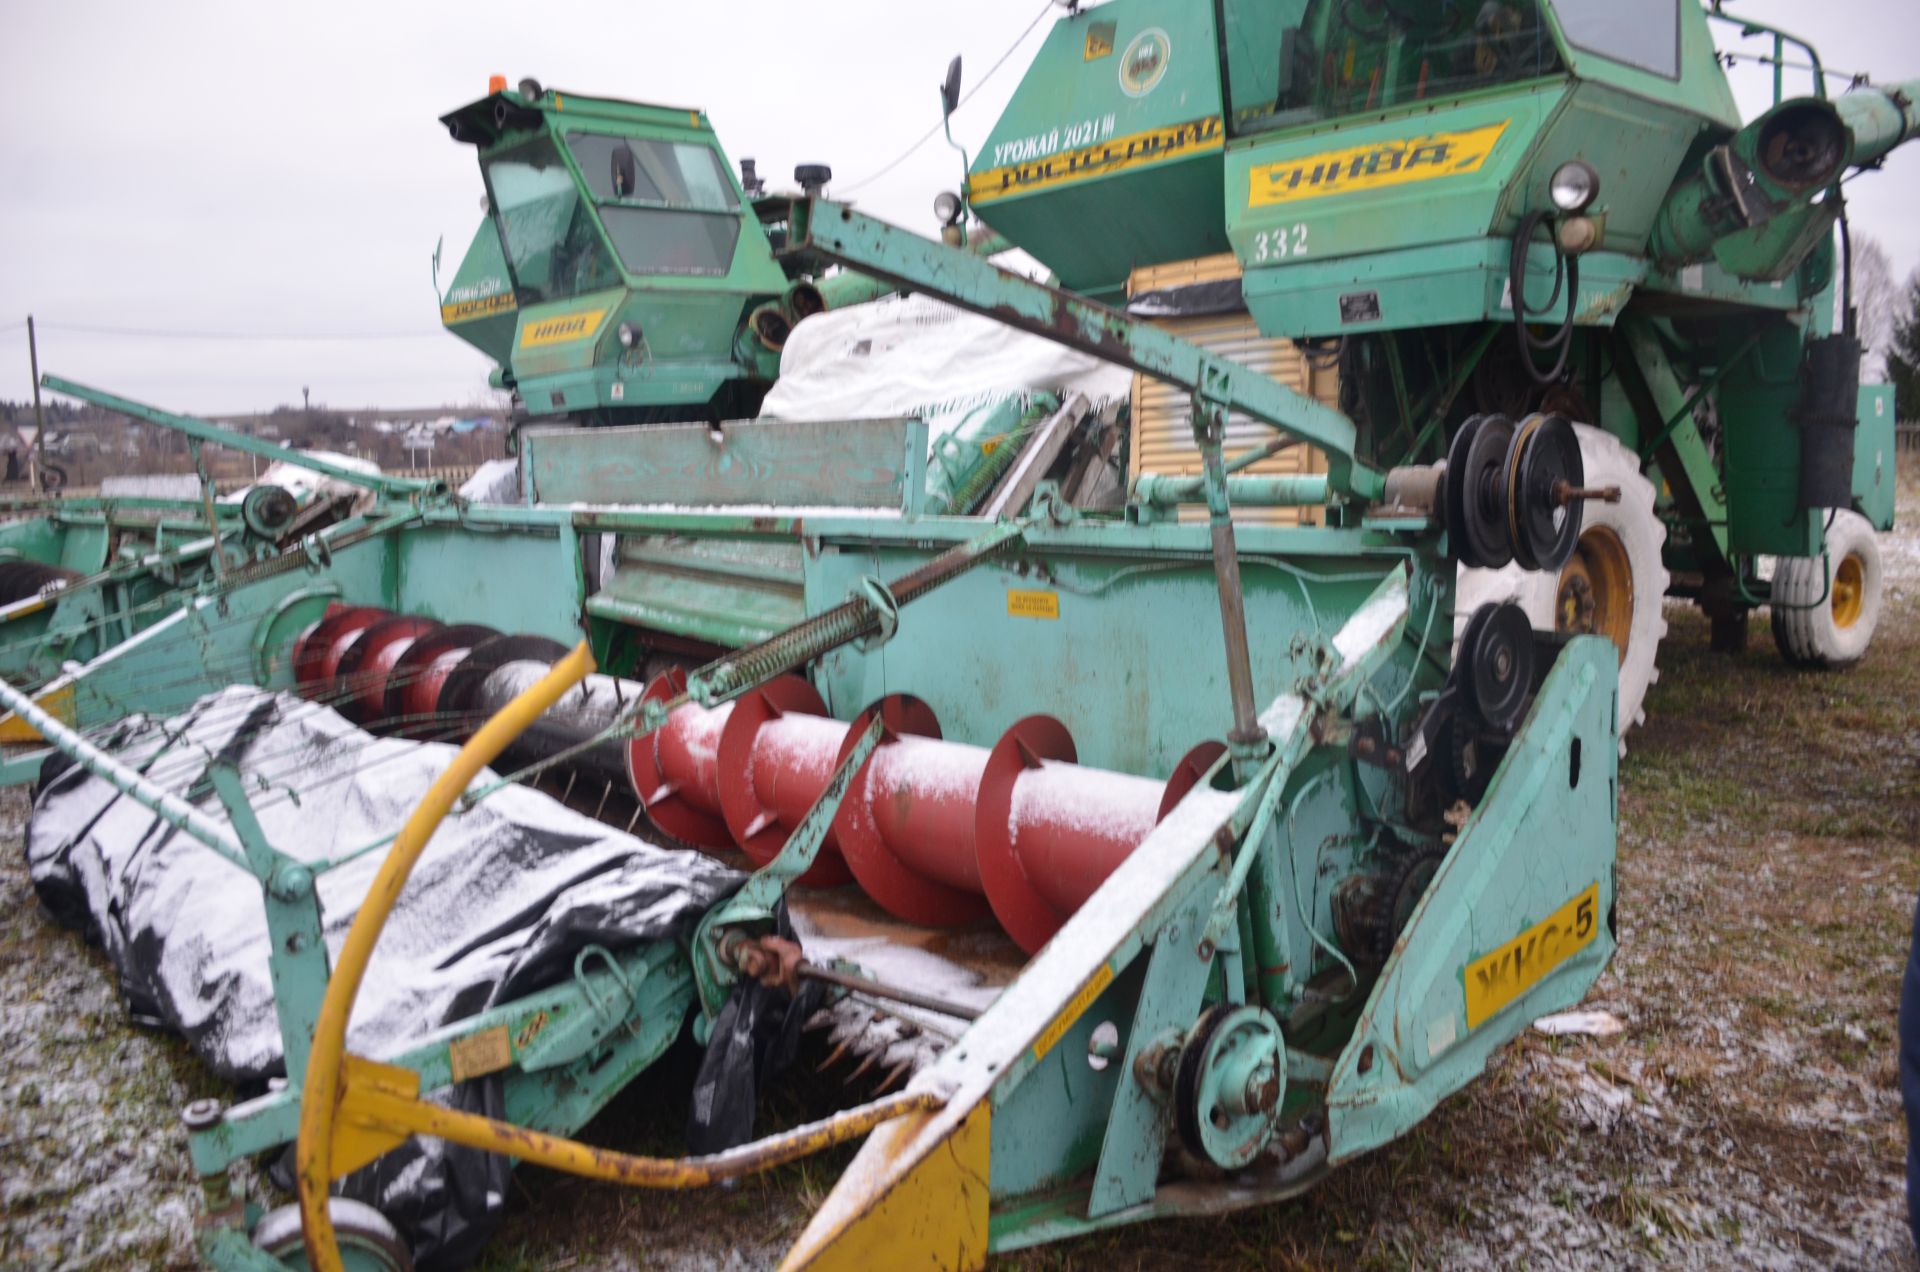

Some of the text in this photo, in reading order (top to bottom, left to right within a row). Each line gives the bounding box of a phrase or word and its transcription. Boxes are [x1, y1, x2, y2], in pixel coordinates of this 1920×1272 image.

[993, 131, 1059, 167] УРОЖАЙ
[1287, 142, 1451, 190] НИВА
[1254, 222, 1308, 263] 332
[534, 317, 587, 340] НИВА
